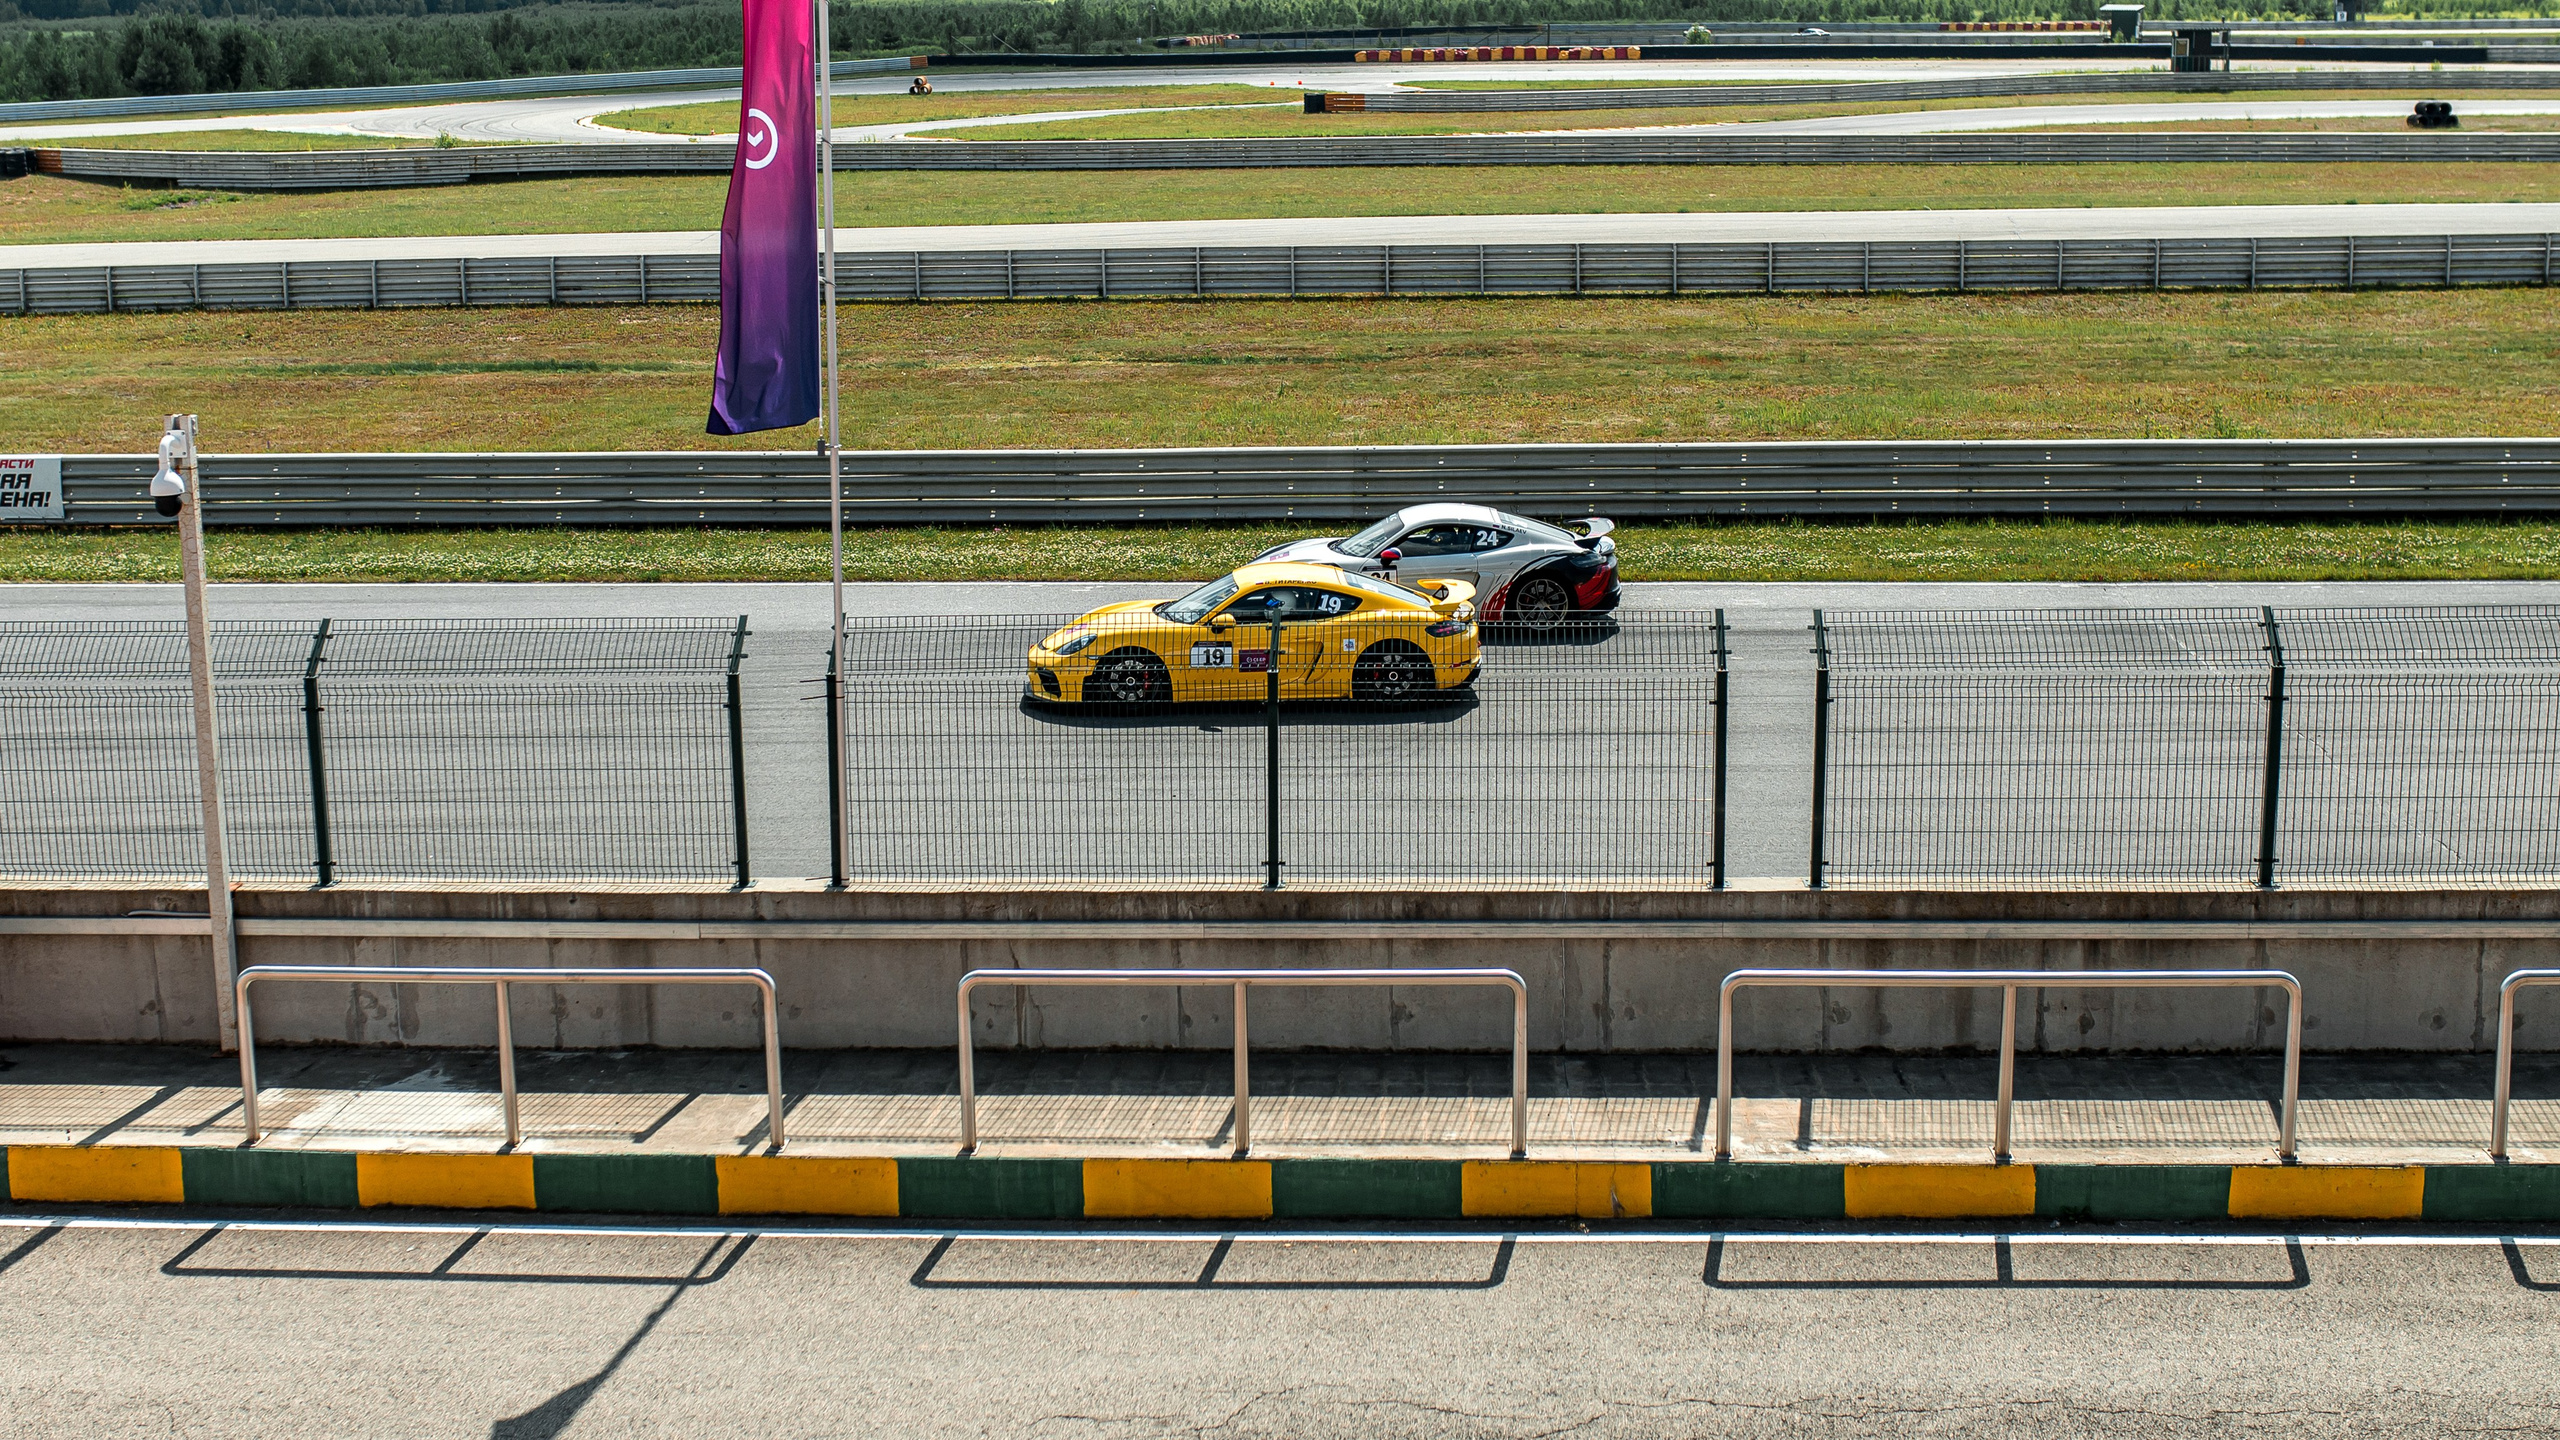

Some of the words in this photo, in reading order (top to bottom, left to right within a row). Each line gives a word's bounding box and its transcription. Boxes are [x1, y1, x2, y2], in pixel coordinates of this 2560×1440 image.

[0, 473, 32, 489] АЯ
[1476, 530, 1499, 546] 24
[1317, 594, 1341, 614] 19
[1203, 648, 1224, 666] 19
